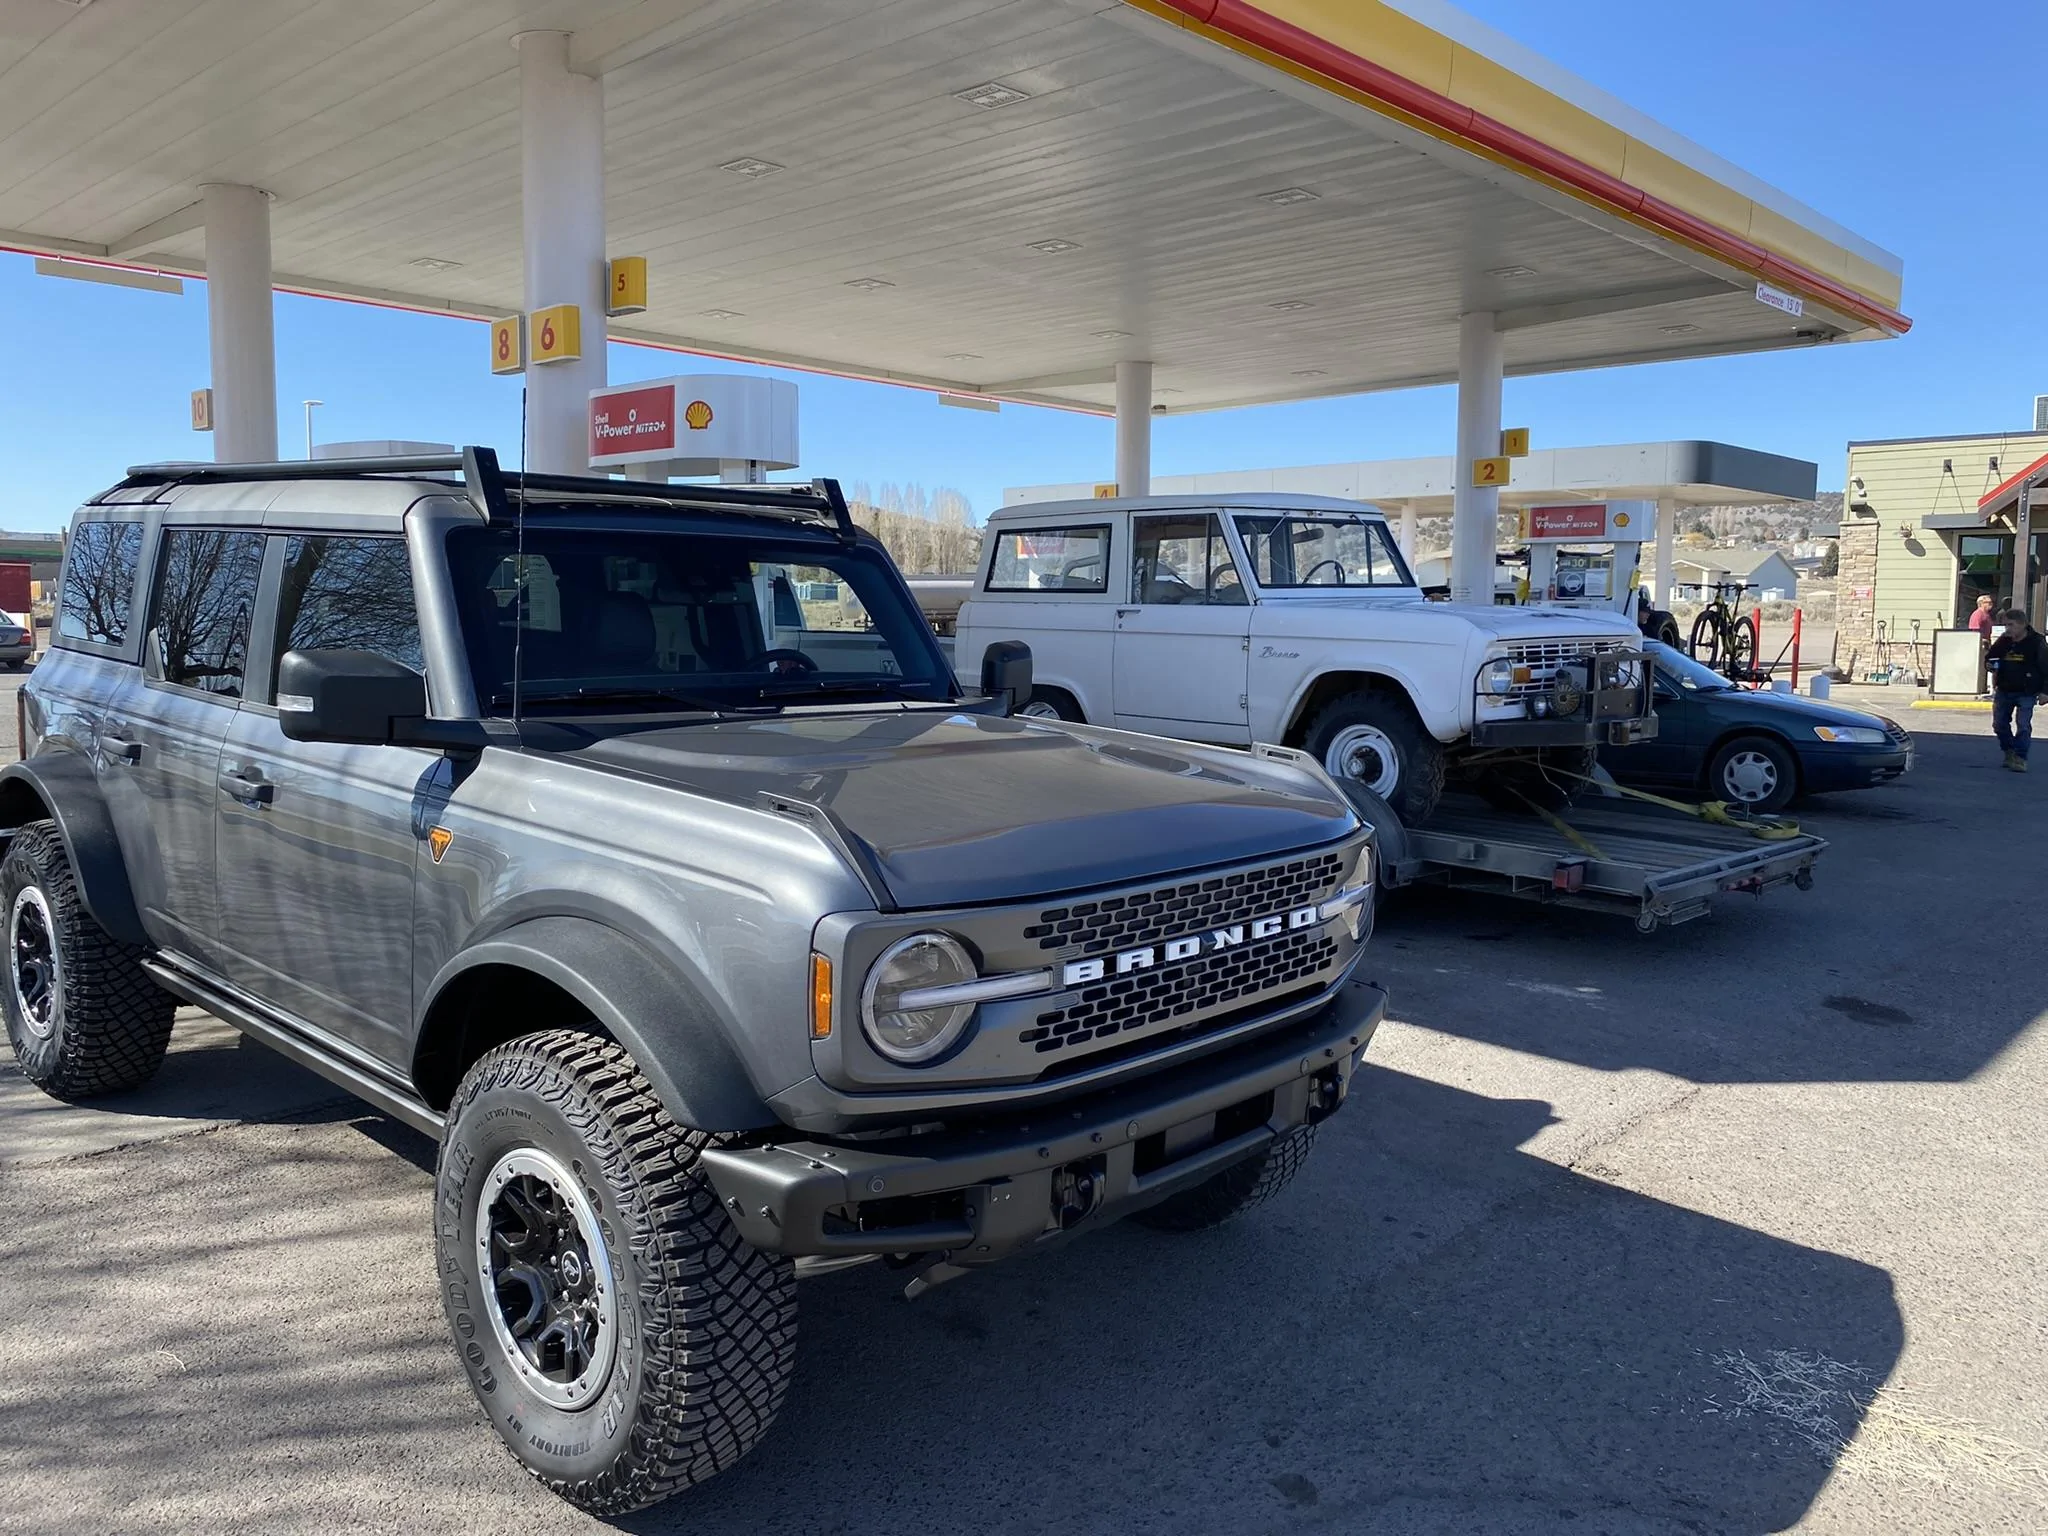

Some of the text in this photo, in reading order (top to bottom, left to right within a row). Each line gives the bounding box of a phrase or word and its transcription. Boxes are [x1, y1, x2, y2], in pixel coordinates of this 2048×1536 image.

[617, 273, 626, 292] 5
[498, 328, 510, 361] 8
[540, 317, 555, 351] 6
[192, 398, 205, 421] 10
[594, 412, 609, 425] Shell
[594, 423, 634, 439] V-Power
[1512, 437, 1517, 448] 1
[1482, 462, 1496, 481] 2
[1258, 646, 1300, 659] Bronco
[1062, 905, 1318, 986] BRONCO
[439, 1141, 498, 1394] GOODYEAR
[571, 1158, 638, 1439] GOODYEAR
[528, 1434, 592, 1457] TERRITORY
